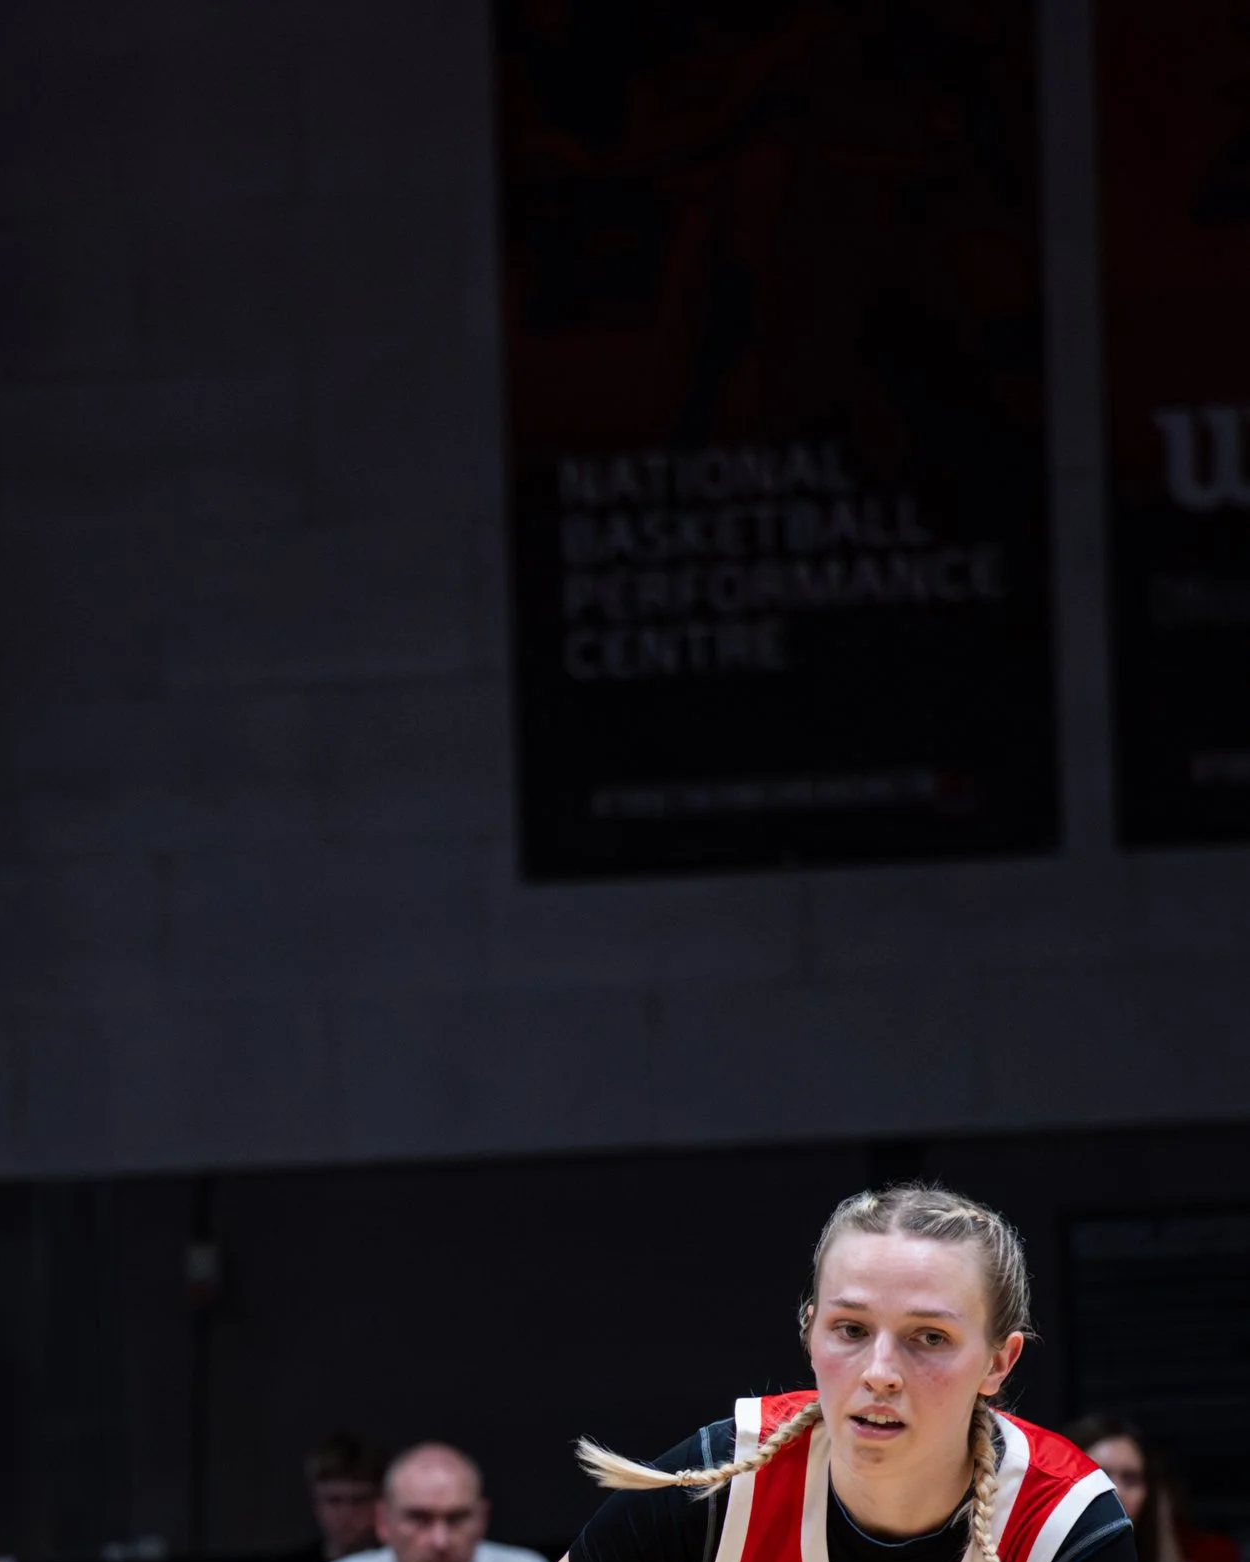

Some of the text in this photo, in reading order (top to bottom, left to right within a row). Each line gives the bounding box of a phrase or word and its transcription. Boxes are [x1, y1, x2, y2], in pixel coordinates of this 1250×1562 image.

[560, 444, 853, 501] NATIONAL
[561, 493, 928, 561] BASKETBALL
[562, 541, 1002, 614] PERFORMANCE
[565, 617, 790, 679] CENTRE
